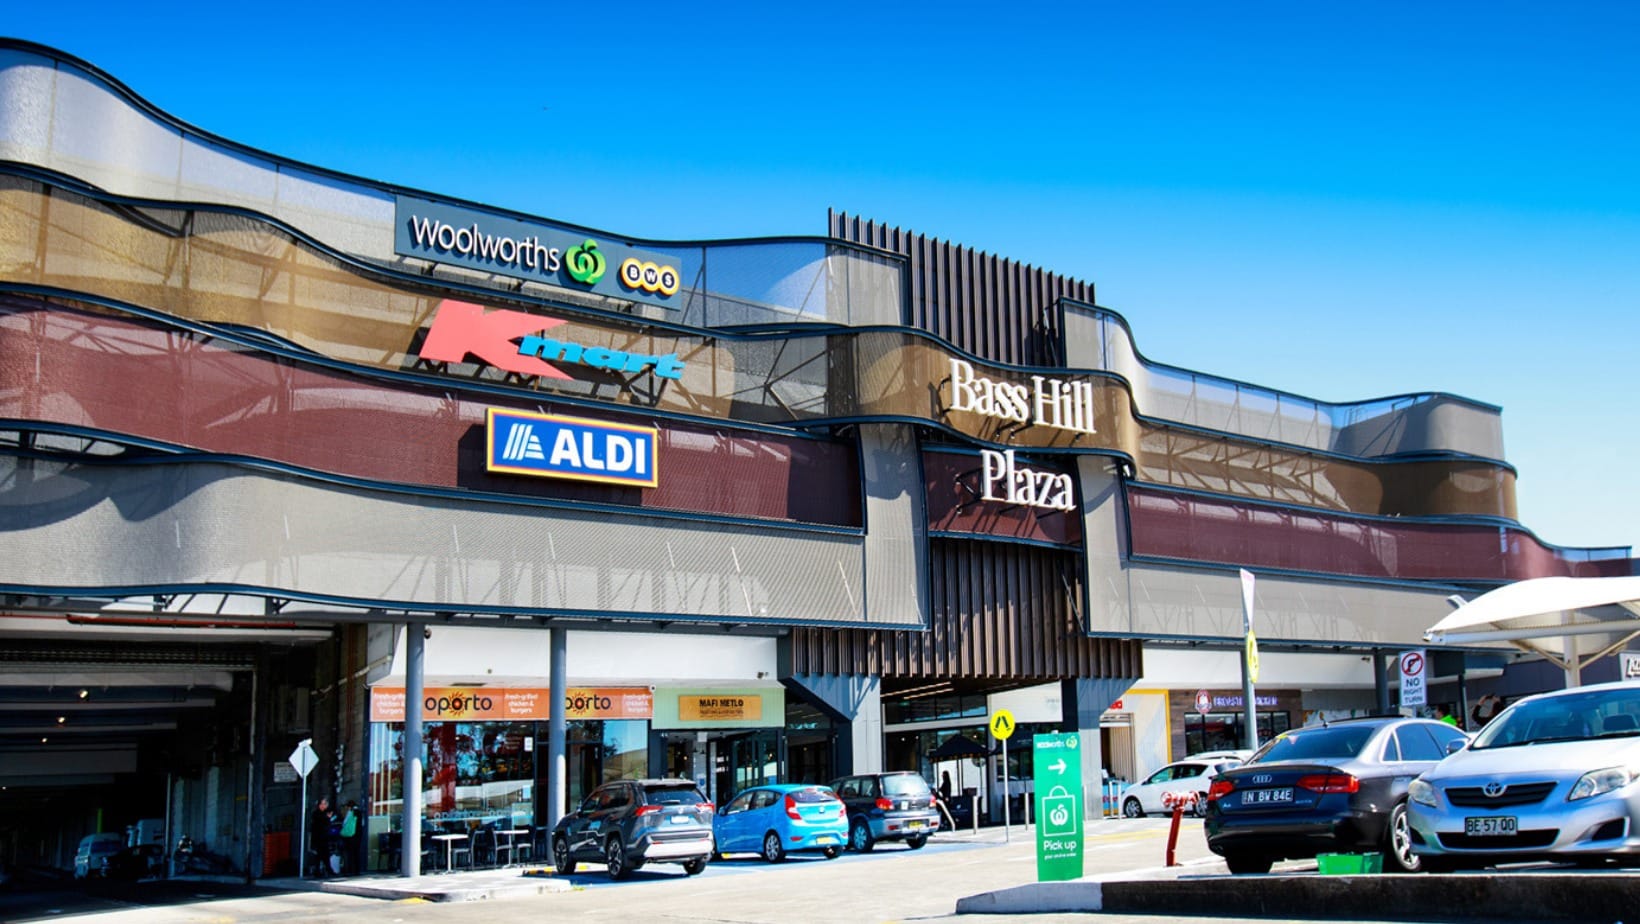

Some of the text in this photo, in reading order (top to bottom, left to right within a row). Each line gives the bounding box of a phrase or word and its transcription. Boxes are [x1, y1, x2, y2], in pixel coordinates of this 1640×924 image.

[412, 214, 561, 272] Woolworths
[419, 299, 686, 381] Kmart
[950, 358, 1097, 434] Bass Hill
[550, 428, 646, 475] ALDI
[980, 449, 1076, 511] Plaza
[1403, 687, 1422, 696] RIGHT
[1406, 677, 1420, 687] NO
[425, 694, 493, 715] oporto
[699, 699, 718, 707] MAFI
[1044, 840, 1077, 852] Pick up
